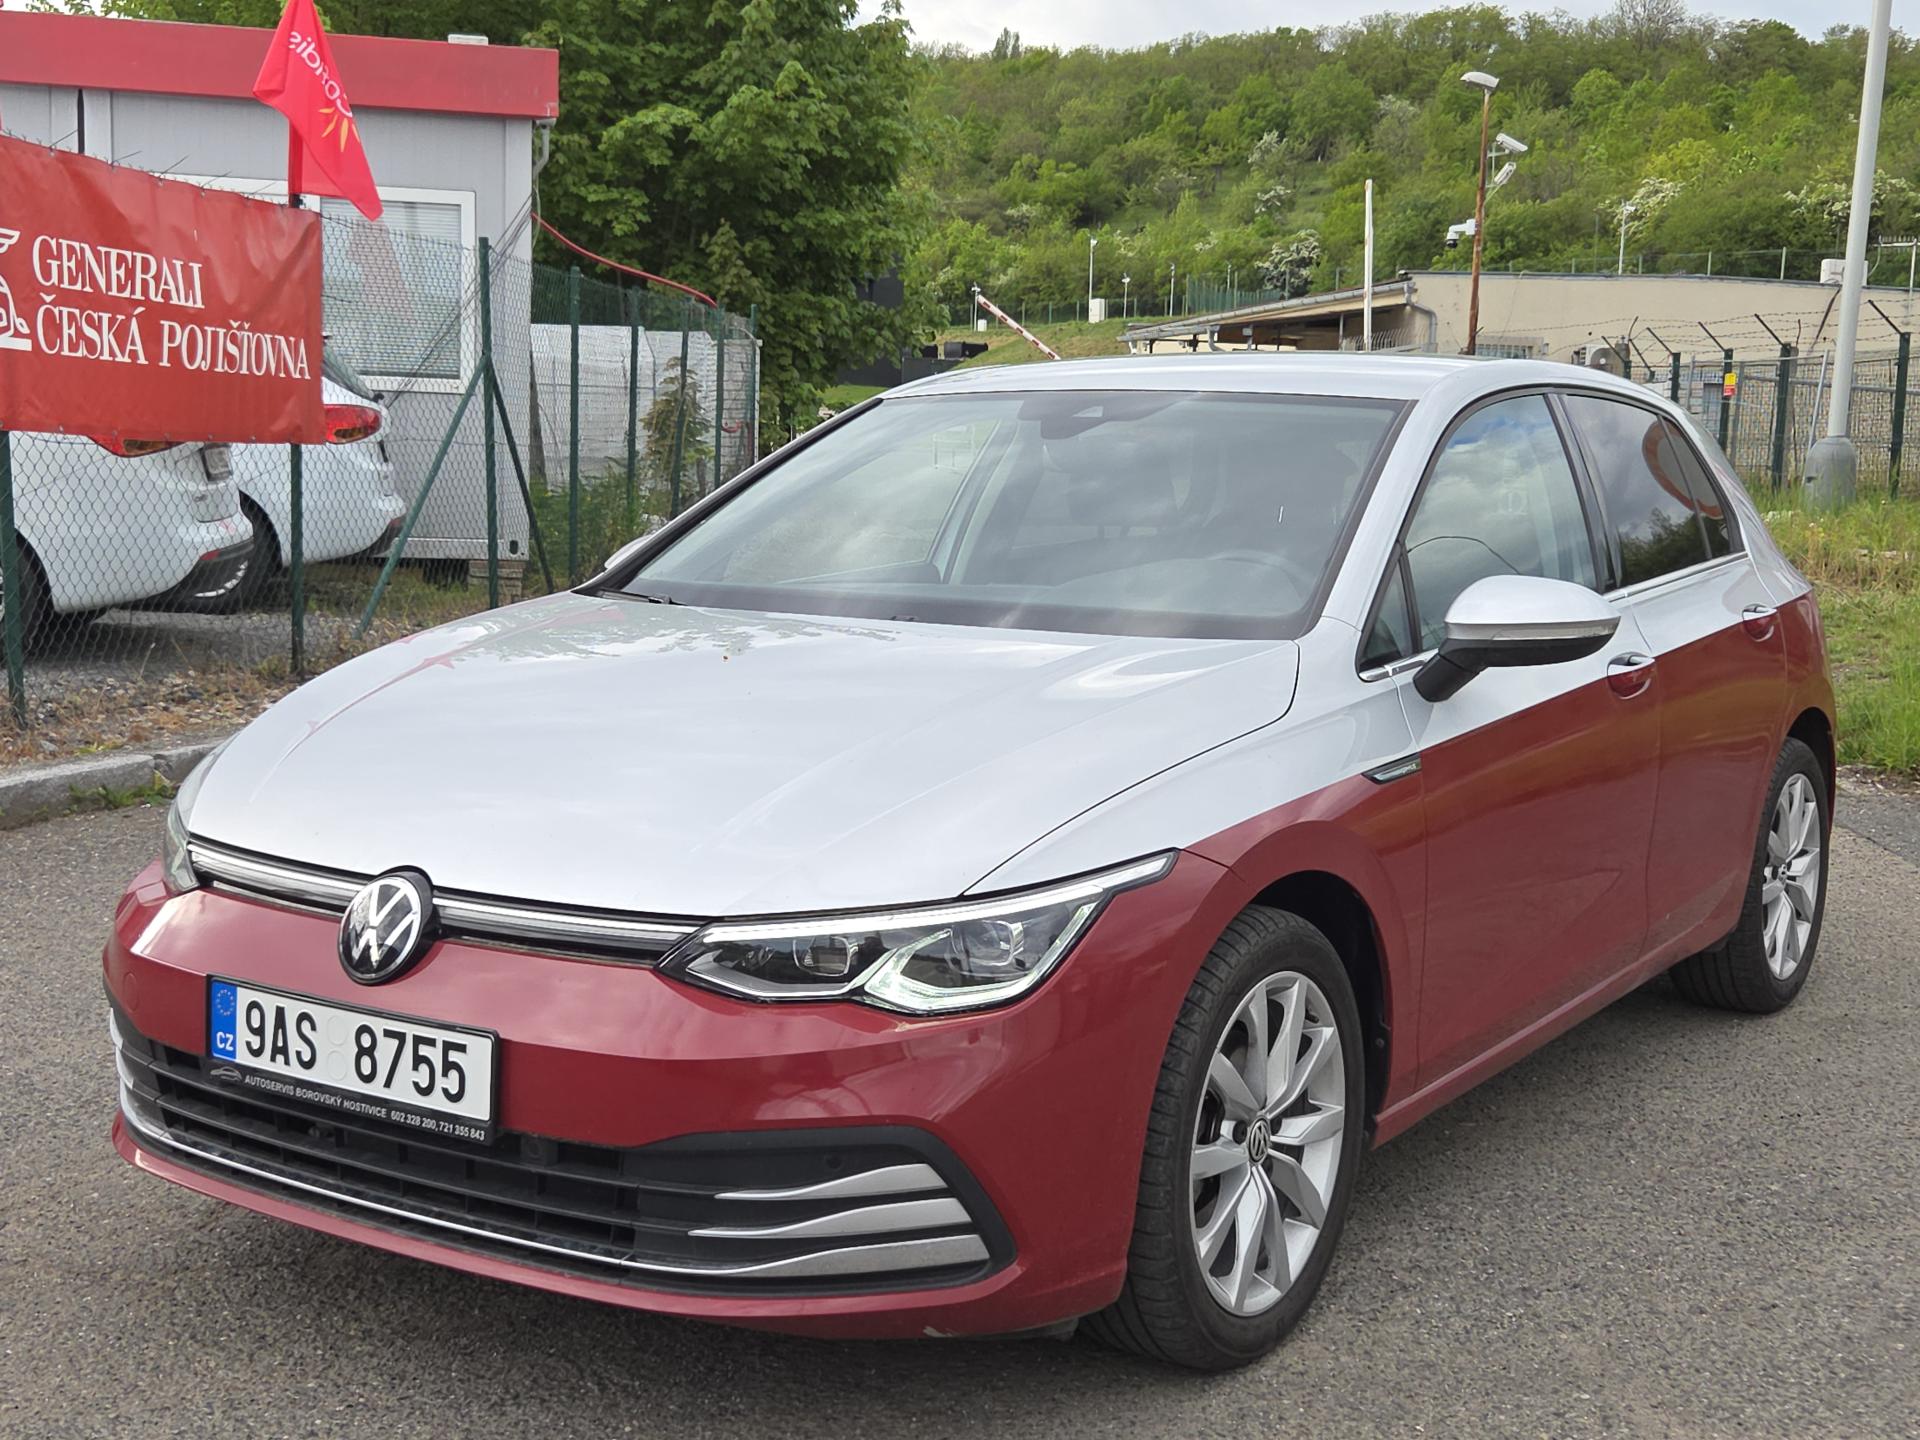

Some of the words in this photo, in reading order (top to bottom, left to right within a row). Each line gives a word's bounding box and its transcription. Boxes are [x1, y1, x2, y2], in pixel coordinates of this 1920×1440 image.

[33, 235, 205, 308] GENERALI
[36, 292, 149, 365] ČESKÁ
[159, 319, 311, 380] POJIŠŤOVNA
[216, 1031, 234, 1051] CZ
[245, 1000, 317, 1070] 9AS
[354, 1024, 468, 1103] 8755
[245, 1075, 294, 1096] AUTOSERVIS
[296, 1086, 342, 1107] BOROVSKÝ
[343, 1098, 387, 1118] HOSTIVICE
[391, 1110, 405, 1123] 602
[406, 1114, 421, 1126] 328
[454, 1125, 469, 1137] 355
